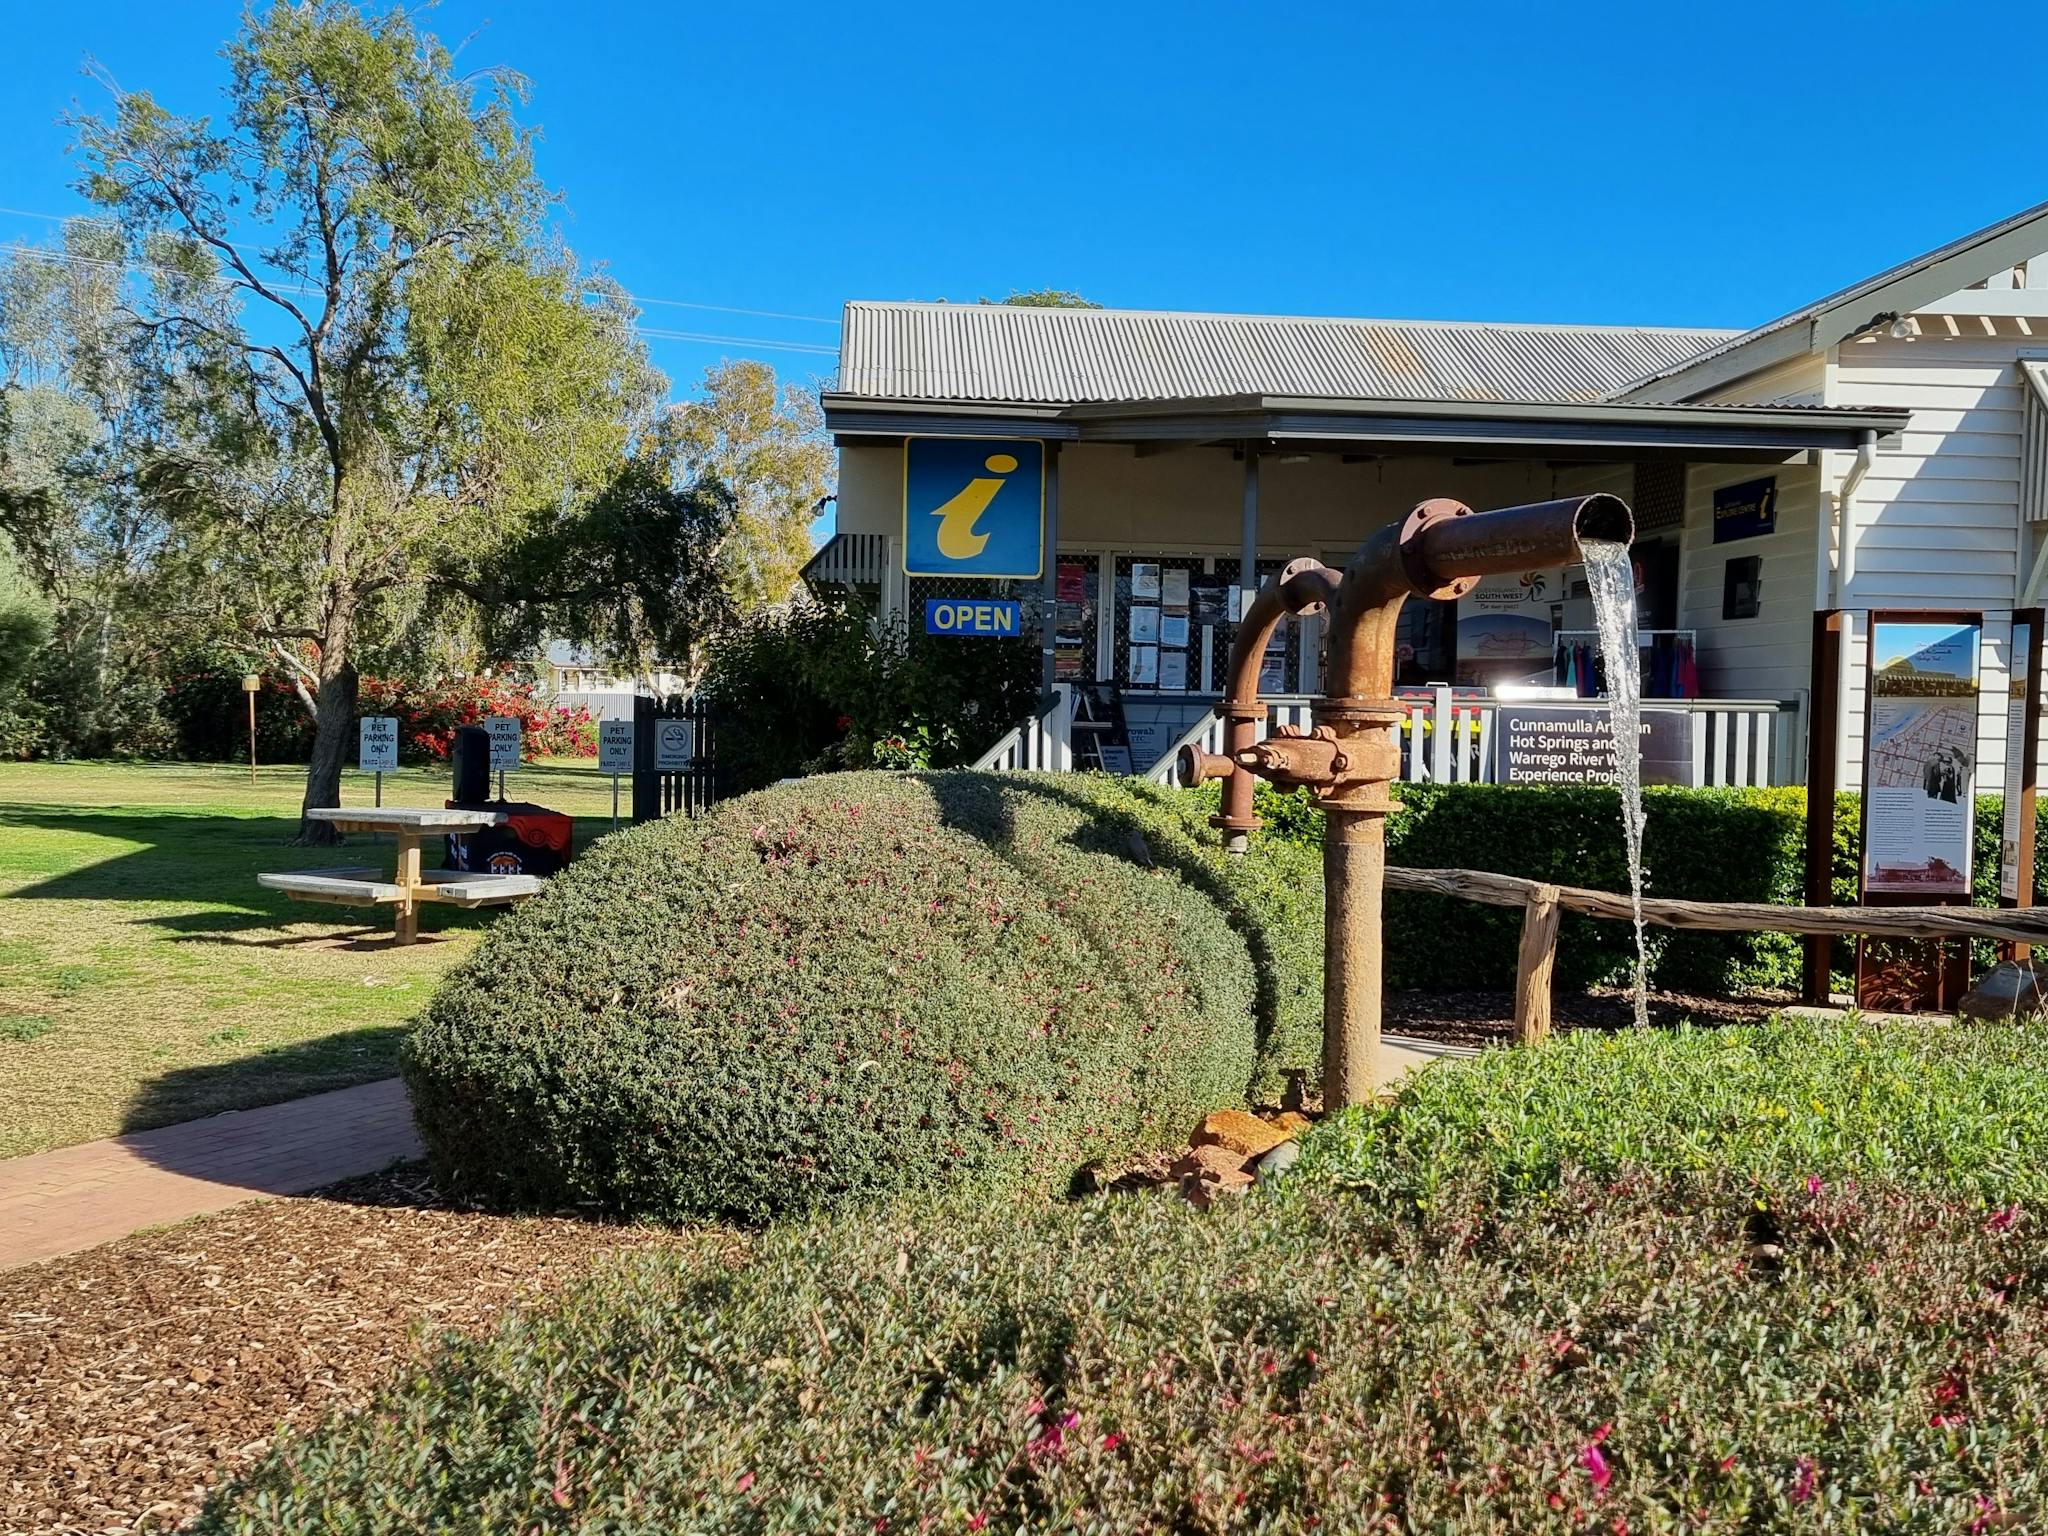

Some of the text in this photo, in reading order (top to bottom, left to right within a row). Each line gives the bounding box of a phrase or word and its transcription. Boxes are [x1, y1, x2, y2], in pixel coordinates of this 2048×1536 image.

[934, 605, 1012, 631] OPEN
[371, 723, 388, 732] PET
[495, 723, 510, 731] PET
[610, 727, 625, 735] PET
[1509, 718, 1651, 735] Cunnamulla Artn
[363, 733, 395, 742] PARKING
[603, 736, 632, 745] PARKING
[494, 744, 513, 752] ONLY
[1510, 735, 1536, 748] Hot
[1538, 735, 1589, 752] Springs
[371, 744, 389, 753] ONLY
[609, 747, 627, 756] ONLY
[1509, 751, 1567, 768] Warrego
[1569, 752, 1605, 766] River
[1509, 767, 1622, 786] Experience Proje
